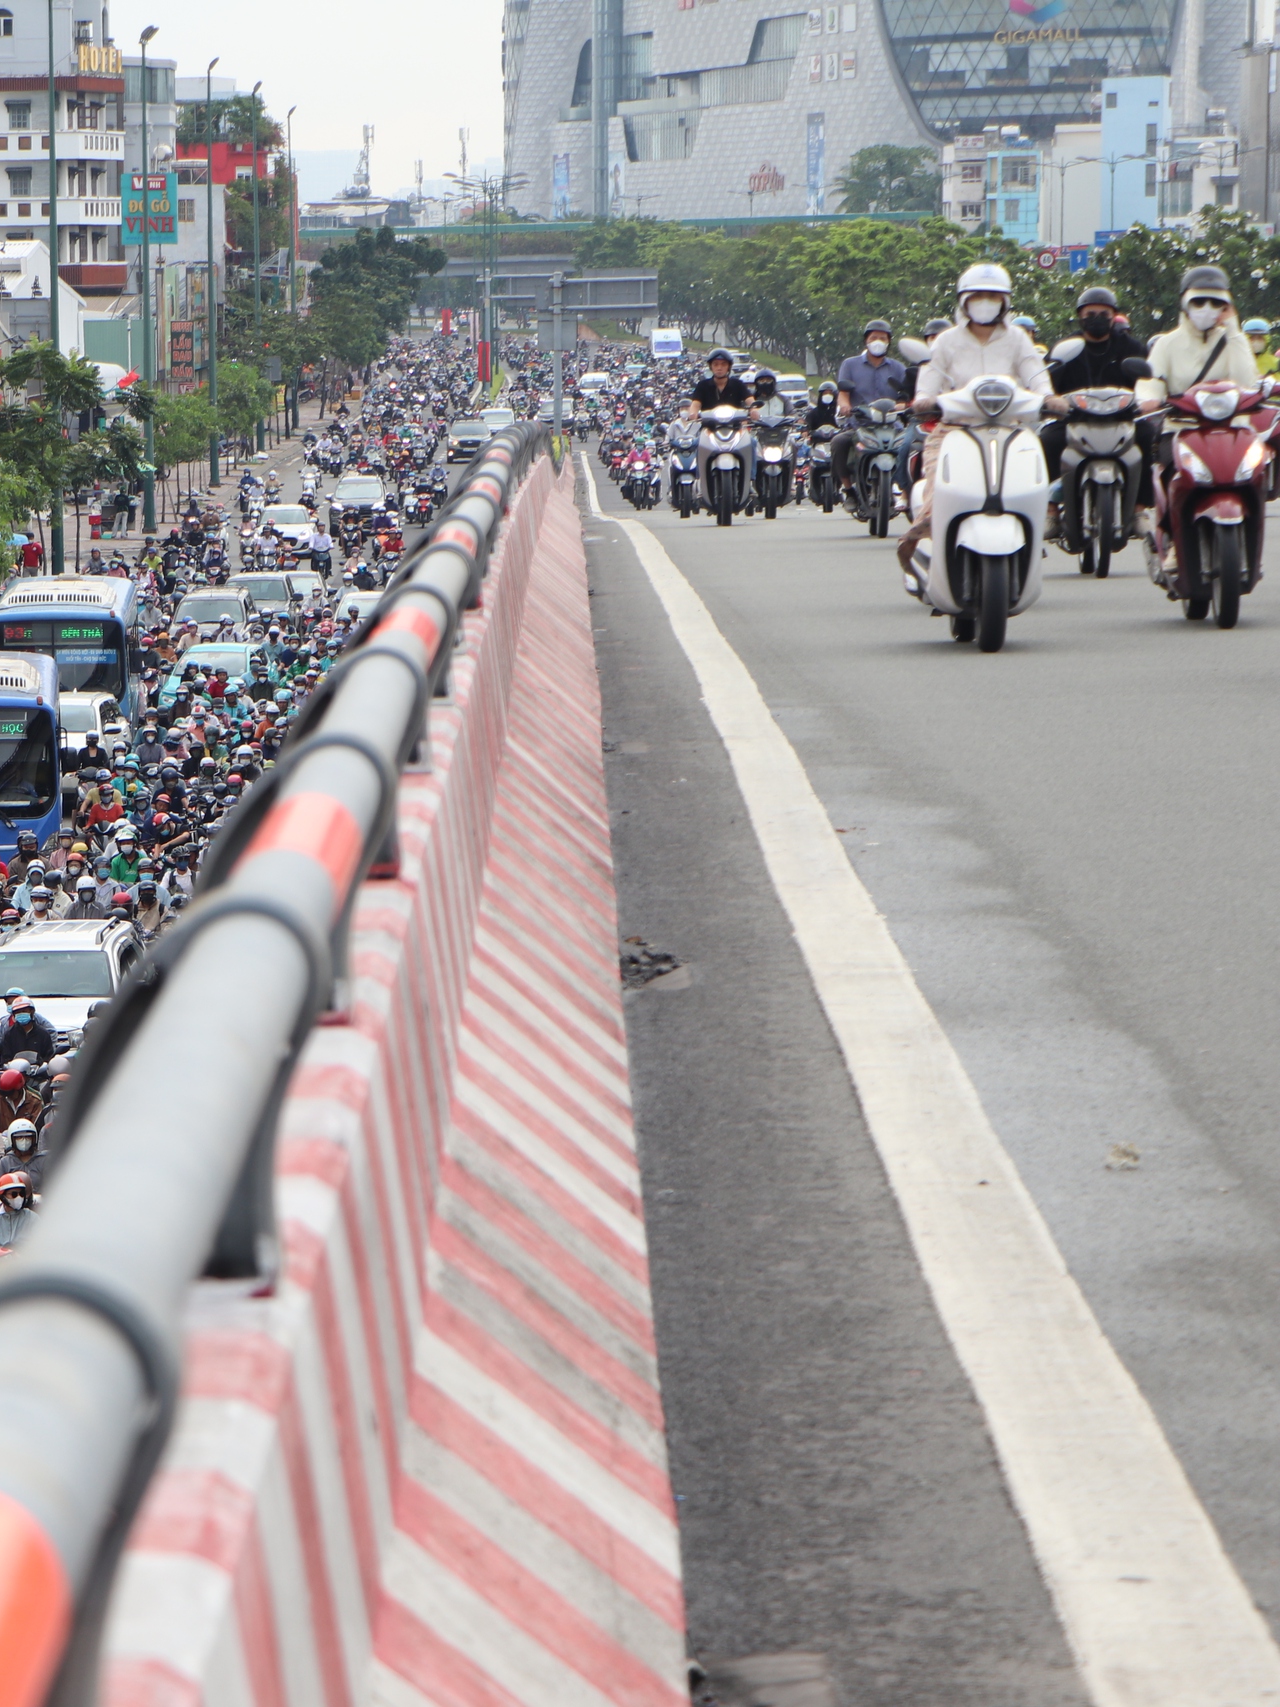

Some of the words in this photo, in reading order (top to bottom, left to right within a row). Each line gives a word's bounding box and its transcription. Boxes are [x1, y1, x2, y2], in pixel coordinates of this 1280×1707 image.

[994, 28, 1084, 45] GIGAMALL
[133, 177, 165, 189] VNH
[151, 190, 170, 213] GỖ
[125, 216, 174, 233] VINH
[4, 627, 24, 639] 93
[61, 626, 80, 638] BẾN
[2, 723, 24, 735] HỌC
